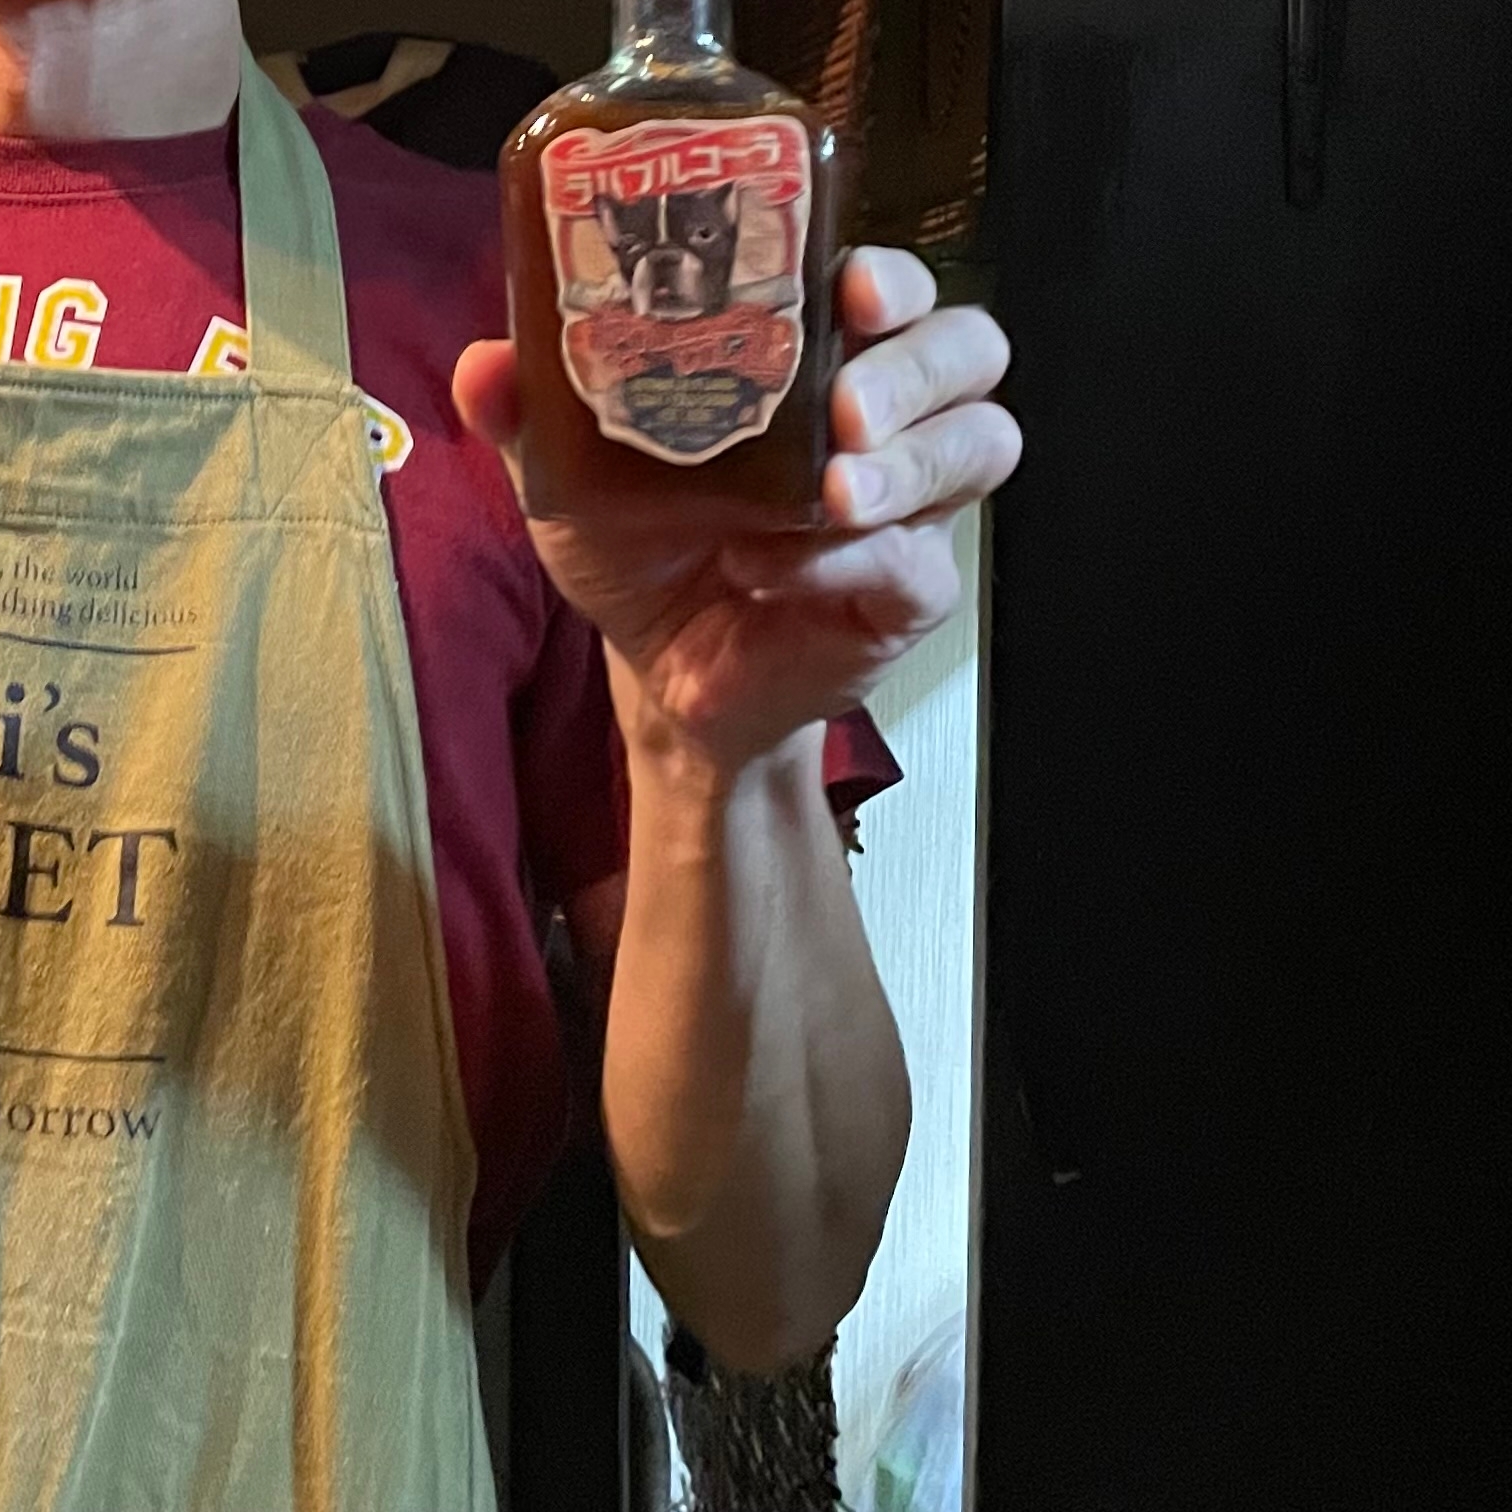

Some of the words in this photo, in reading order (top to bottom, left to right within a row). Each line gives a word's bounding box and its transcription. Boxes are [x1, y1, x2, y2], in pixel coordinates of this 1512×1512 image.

[13, 555, 56, 585] the
[65, 559, 138, 590] world
[79, 597, 199, 629] delicious
